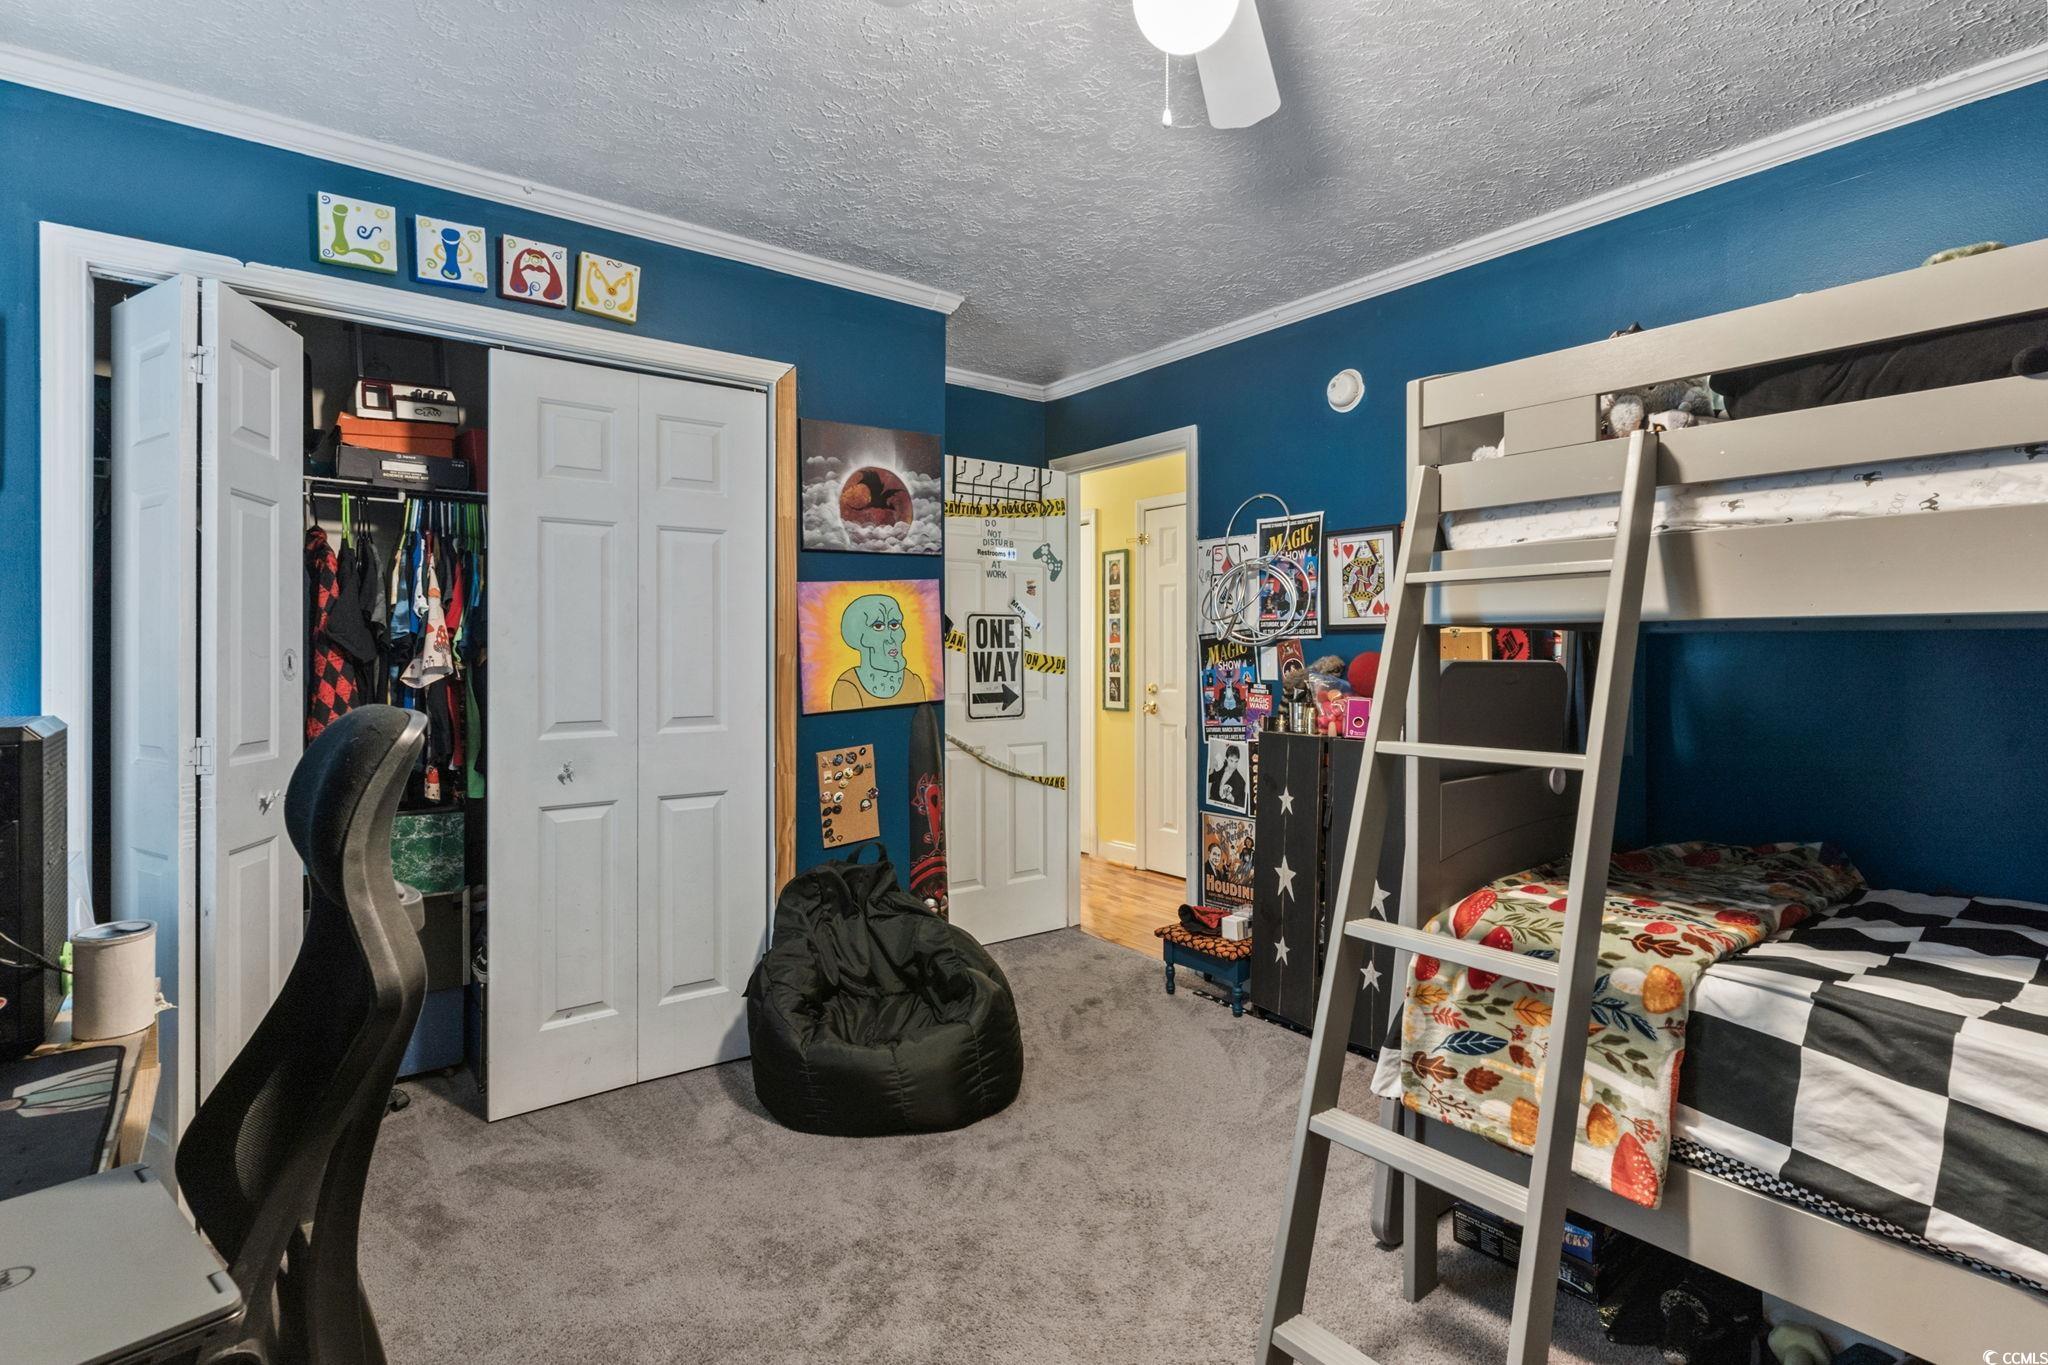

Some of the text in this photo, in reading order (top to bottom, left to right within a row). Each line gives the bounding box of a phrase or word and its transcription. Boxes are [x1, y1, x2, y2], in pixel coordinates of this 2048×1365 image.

[985, 519, 997, 527] DO
[987, 529, 1002, 538] NOT
[982, 538, 1014, 548] DISTURB
[1269, 524, 1314, 555] MAGIC
[977, 548, 1007, 557] Restrooms
[991, 560, 1002, 569] AT
[986, 569, 1008, 579] WORK
[1010, 599, 1027, 618] Men
[976, 618, 1015, 649] ONE
[1208, 641, 1248, 664] MAGIC
[973, 651, 1019, 682] WAY
[1218, 659, 1241, 670] SHOW
[1249, 696, 1270, 704] MAGIC
[1250, 702, 1269, 710] WAND
[1216, 819, 1238, 833] Spirits
[1563, 1232, 1590, 1249] CKS
